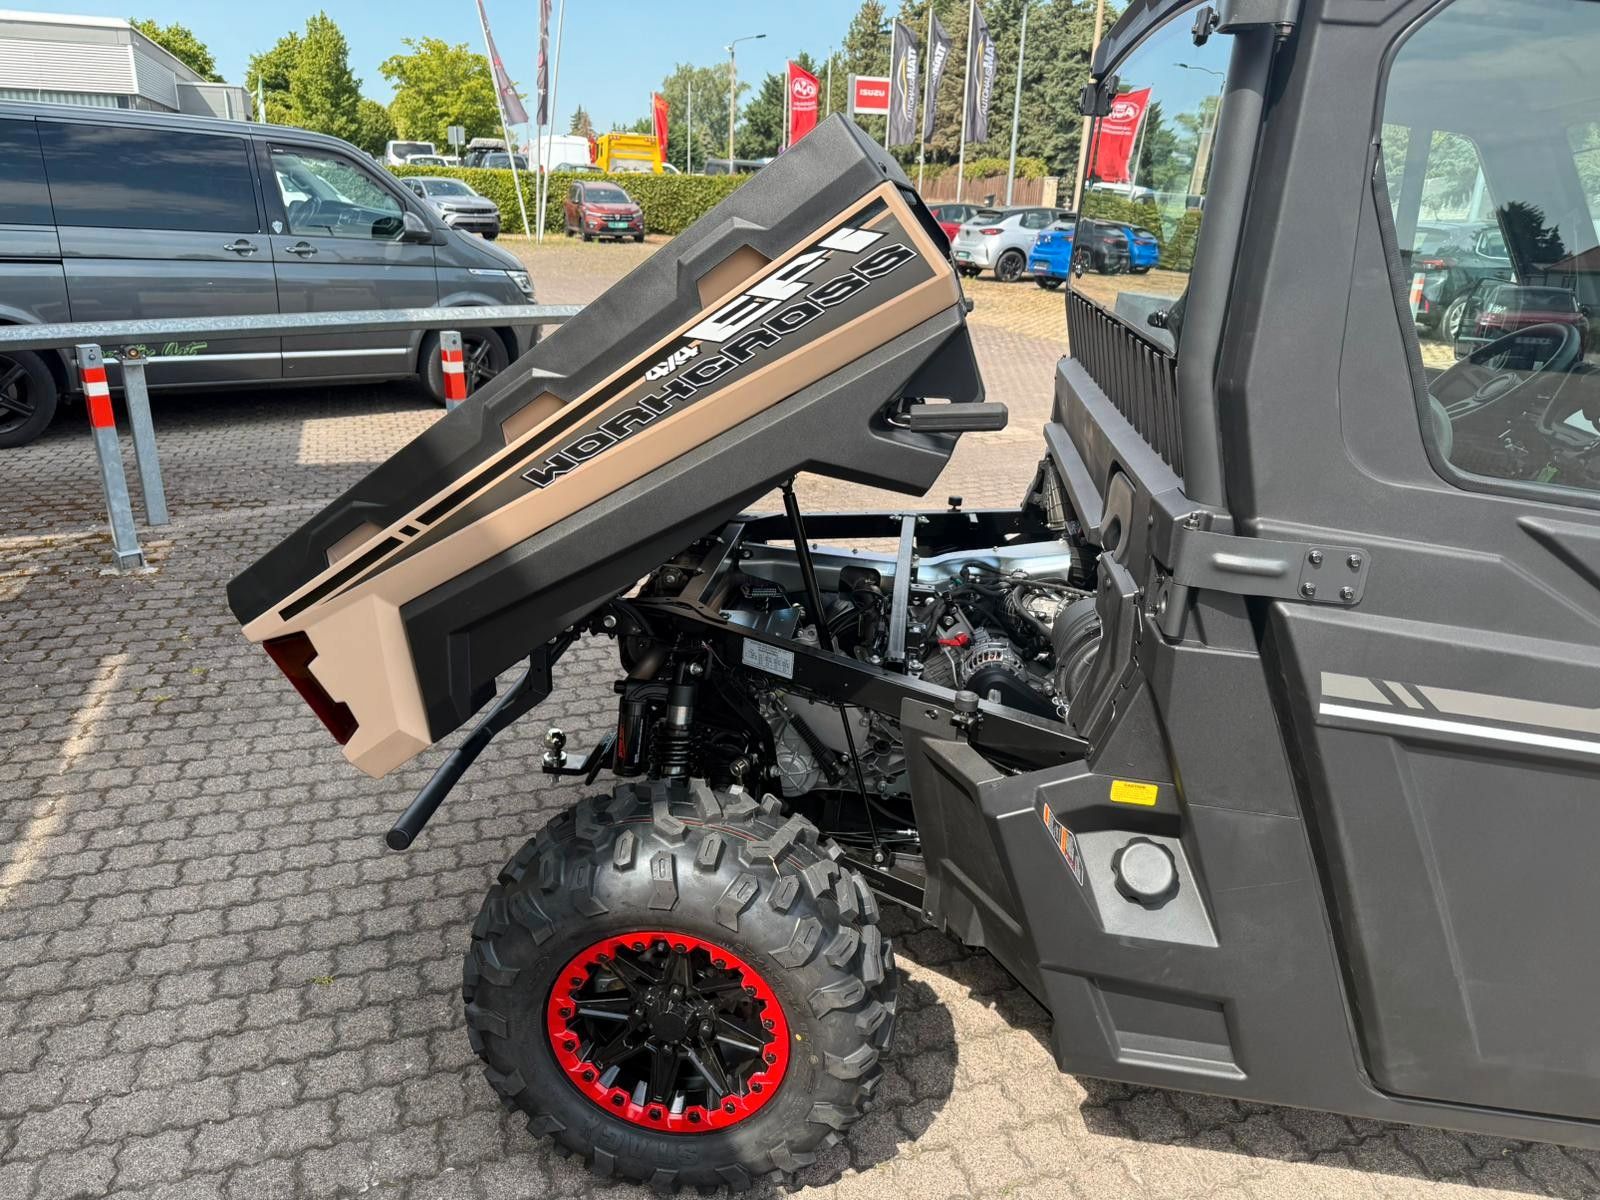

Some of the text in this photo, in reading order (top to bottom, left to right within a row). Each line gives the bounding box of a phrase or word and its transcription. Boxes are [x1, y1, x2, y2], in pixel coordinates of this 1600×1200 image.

[859, 88, 886, 97] ISUZU
[521, 242, 918, 489] WORKCROSS
[645, 227, 886, 381] 4X4 EFI
